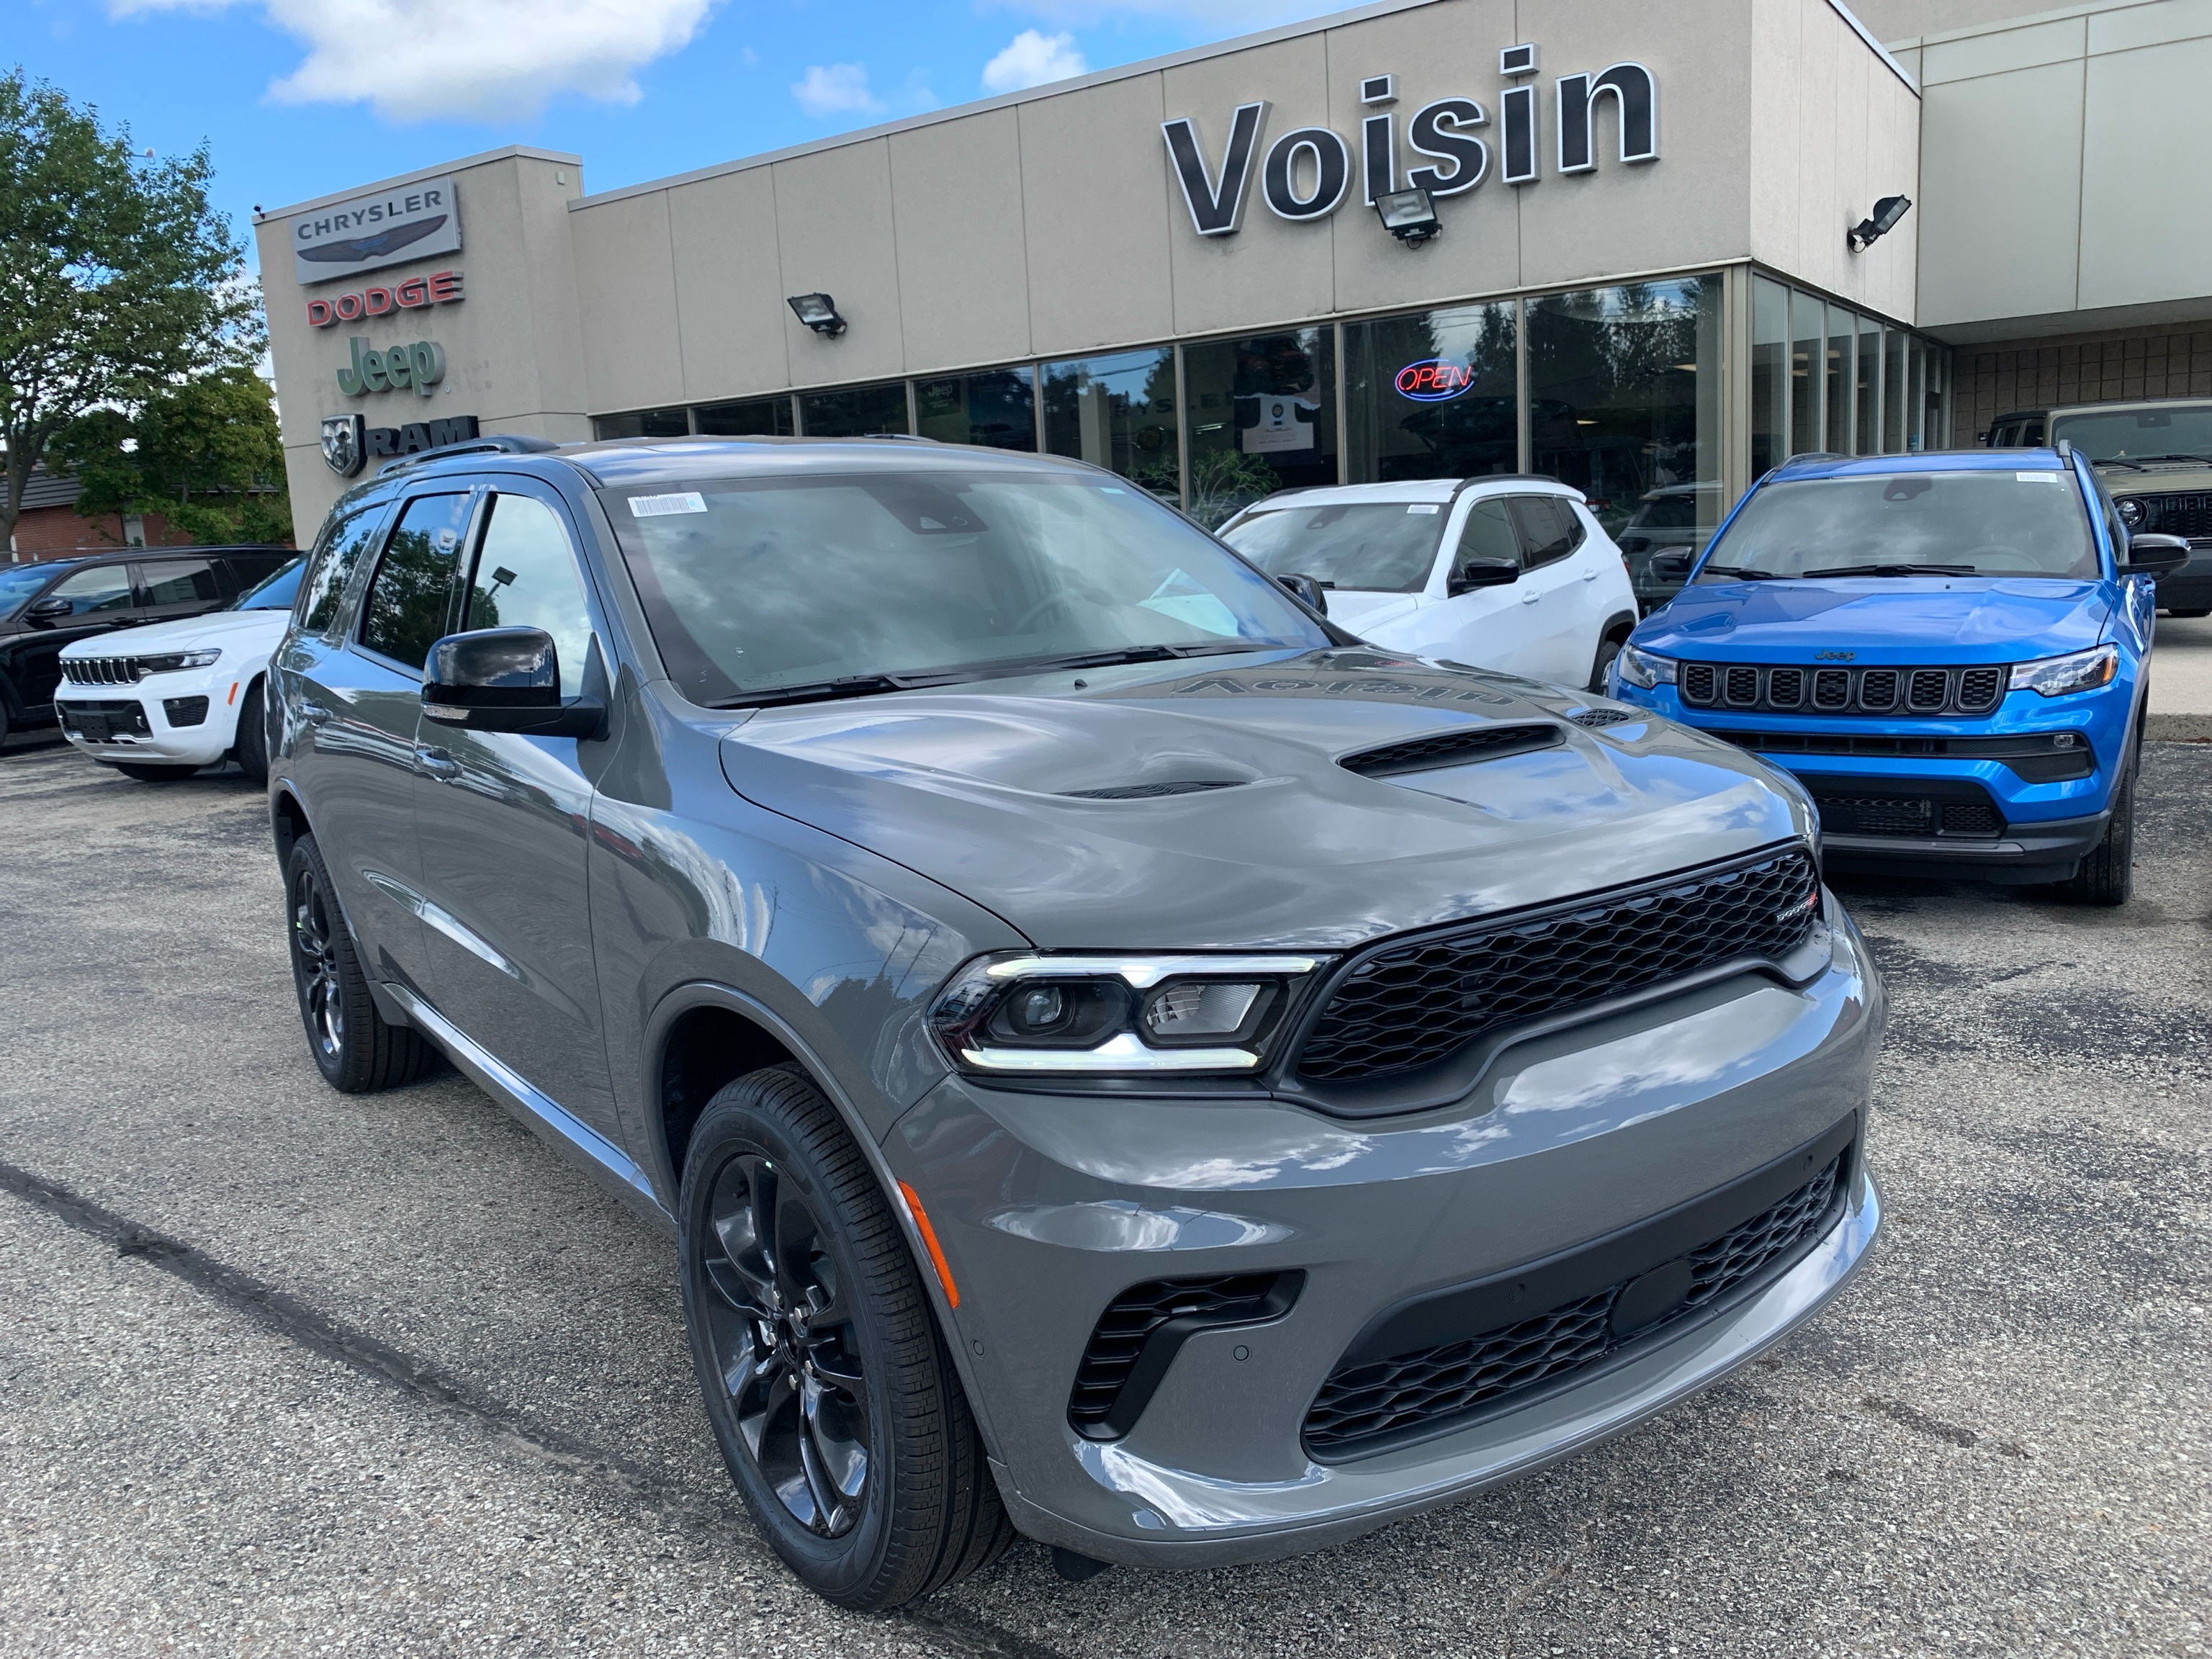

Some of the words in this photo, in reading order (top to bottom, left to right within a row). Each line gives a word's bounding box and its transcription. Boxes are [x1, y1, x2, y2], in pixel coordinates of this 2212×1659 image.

[1160, 42, 1660, 235] Voisin
[297, 190, 443, 240] CHRYSLER
[305, 271, 464, 327] DODGE
[336, 336, 446, 396] Jeep
[1398, 365, 1471, 390] OPEN
[365, 415, 479, 457] RAM
[1815, 649, 1855, 662] Jeep
[1776, 898, 1813, 922] DODGE
